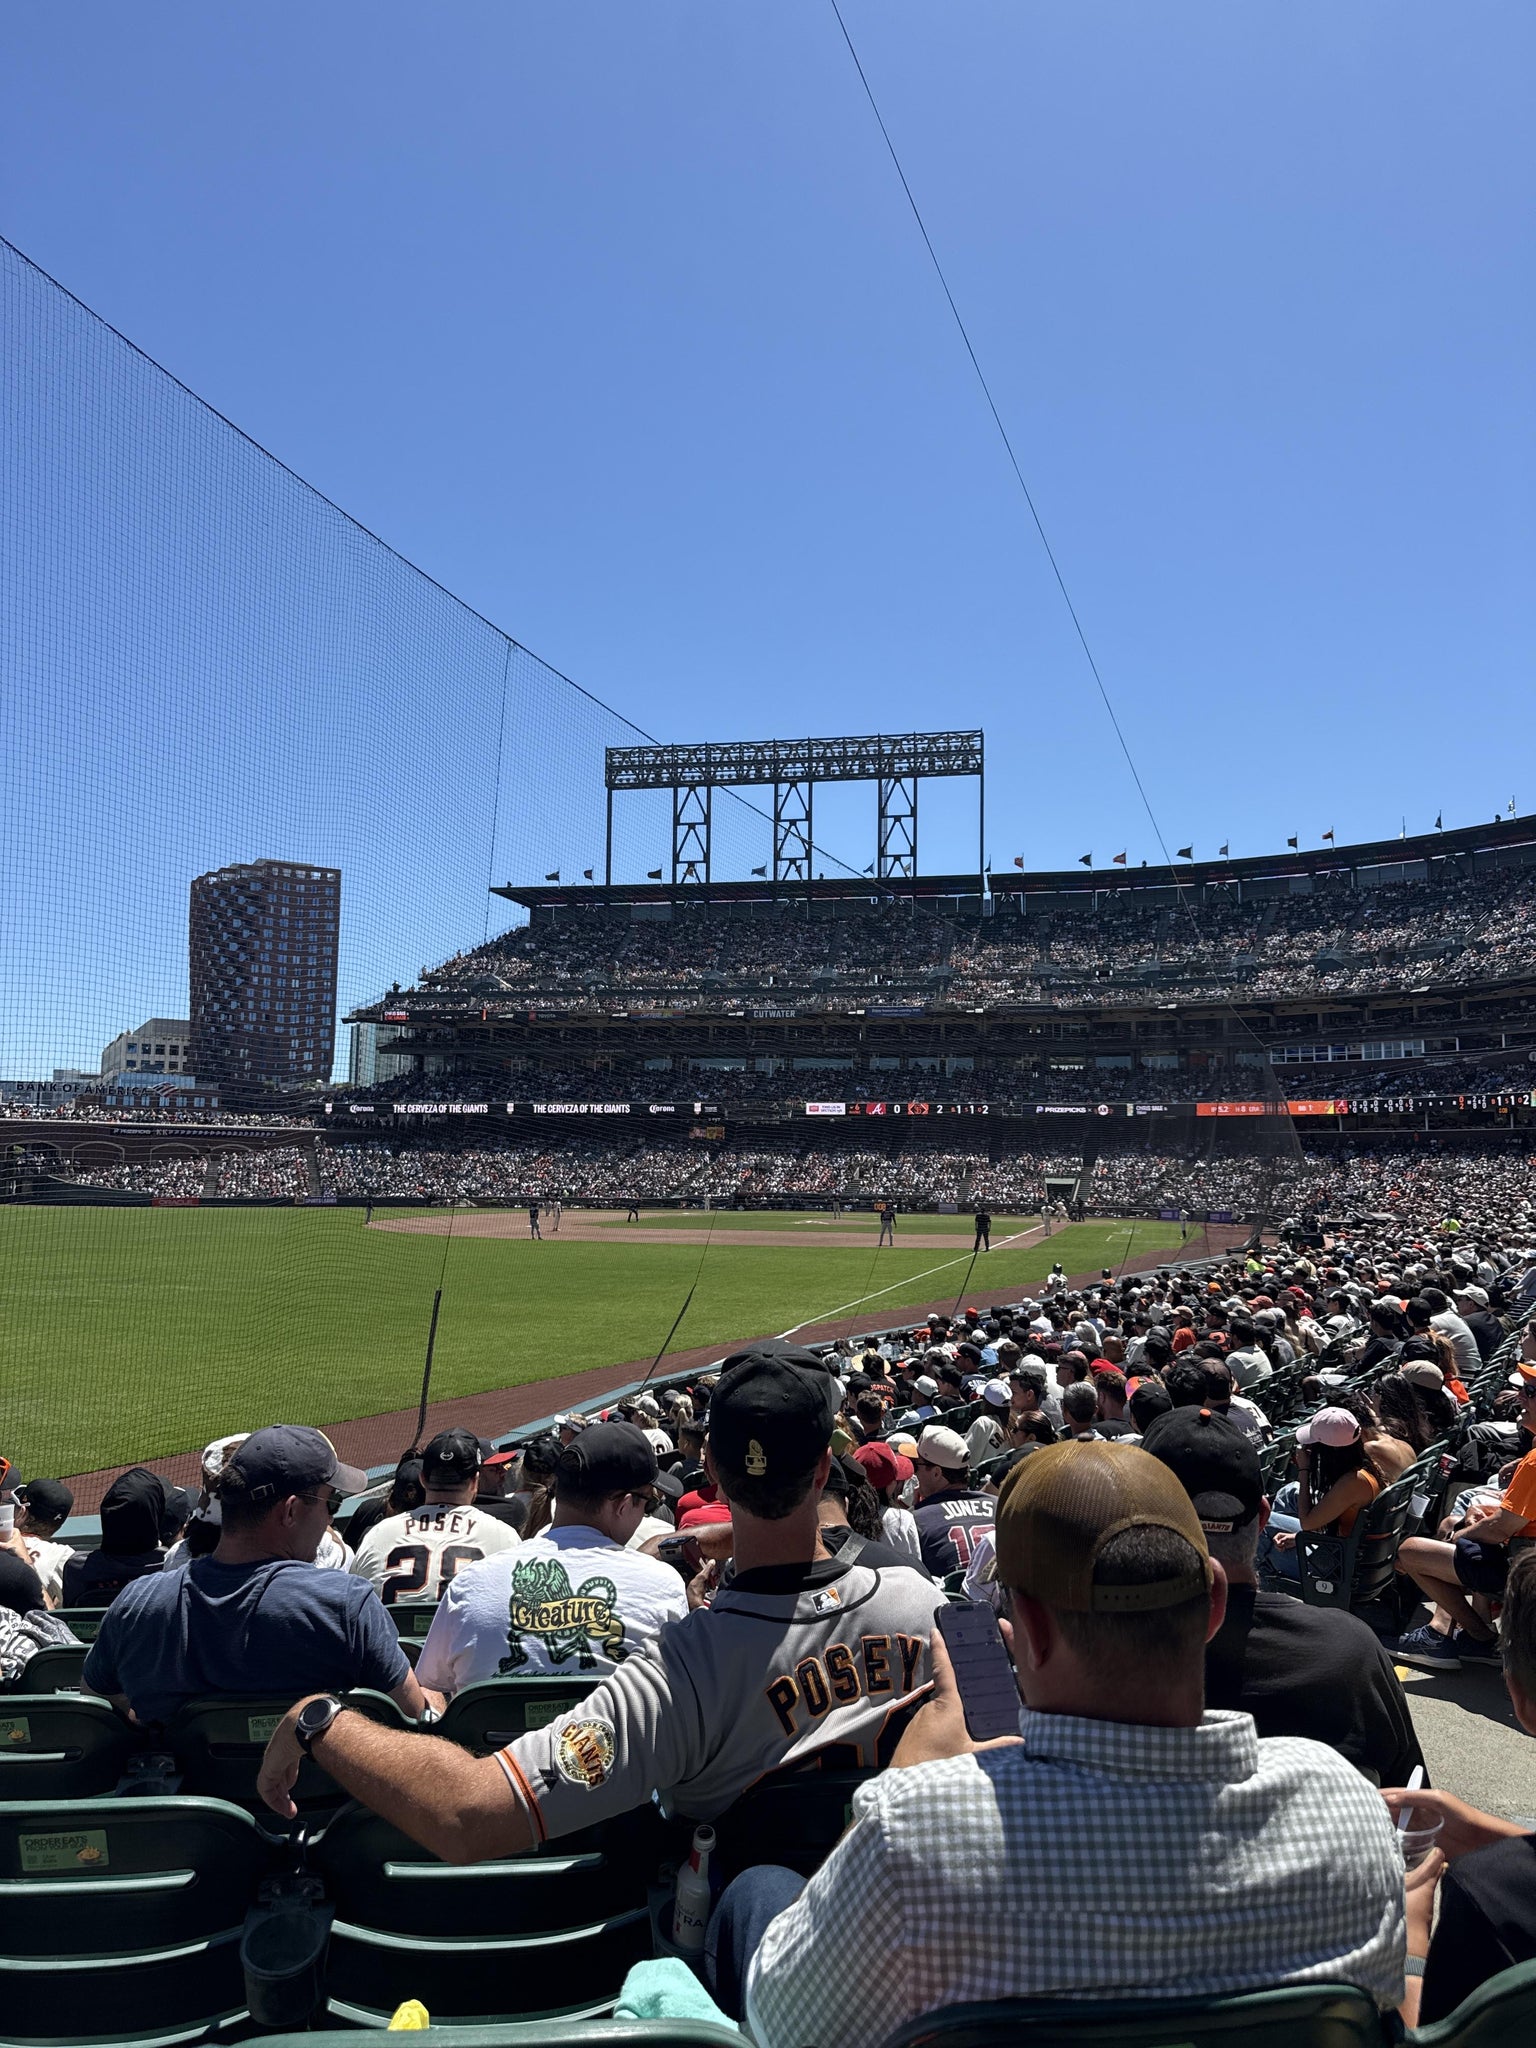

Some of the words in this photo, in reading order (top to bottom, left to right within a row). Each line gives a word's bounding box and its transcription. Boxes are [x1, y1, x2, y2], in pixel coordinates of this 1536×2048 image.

[753, 1009, 796, 1018] CUTWATER
[16, 1080, 58, 1092] BANK
[62, 1083, 81, 1093] OF
[84, 1084, 149, 1096] AMERICA
[1497, 1095, 1502, 1106] 1
[1510, 1095, 1515, 1105] 1
[1522, 1094, 1529, 1105] 2
[349, 1104, 374, 1114] Corona
[392, 1104, 407, 1113] THE
[407, 1104, 438, 1113] CERVEZA
[438, 1104, 448, 1113] OF
[448, 1104, 462, 1113] THE
[462, 1104, 488, 1113] GIANTS
[532, 1104, 547, 1113] THE
[547, 1104, 579, 1113] CERVEZA
[579, 1104, 589, 1113] OF
[589, 1104, 603, 1113] THE
[603, 1104, 630, 1113] GIANTS
[649, 1104, 675, 1114] Corona
[893, 1105, 900, 1113] 0
[936, 1105, 943, 1113] 2
[956, 1105, 962, 1113] 1
[970, 1105, 975, 1113] 1
[982, 1105, 988, 1113] 2
[941, 1500, 993, 1520] JONES
[405, 1512, 477, 1536] POSEY
[1202, 1523, 1231, 1531] GIANTS
[1321, 1582, 1328, 1591] 9
[515, 1599, 609, 1630] Creature
[766, 1633, 924, 1740] POSEY
[562, 1723, 605, 1786] GIANTS
[25, 1838, 61, 1847] ORDER
[62, 1835, 88, 1845] EATS
